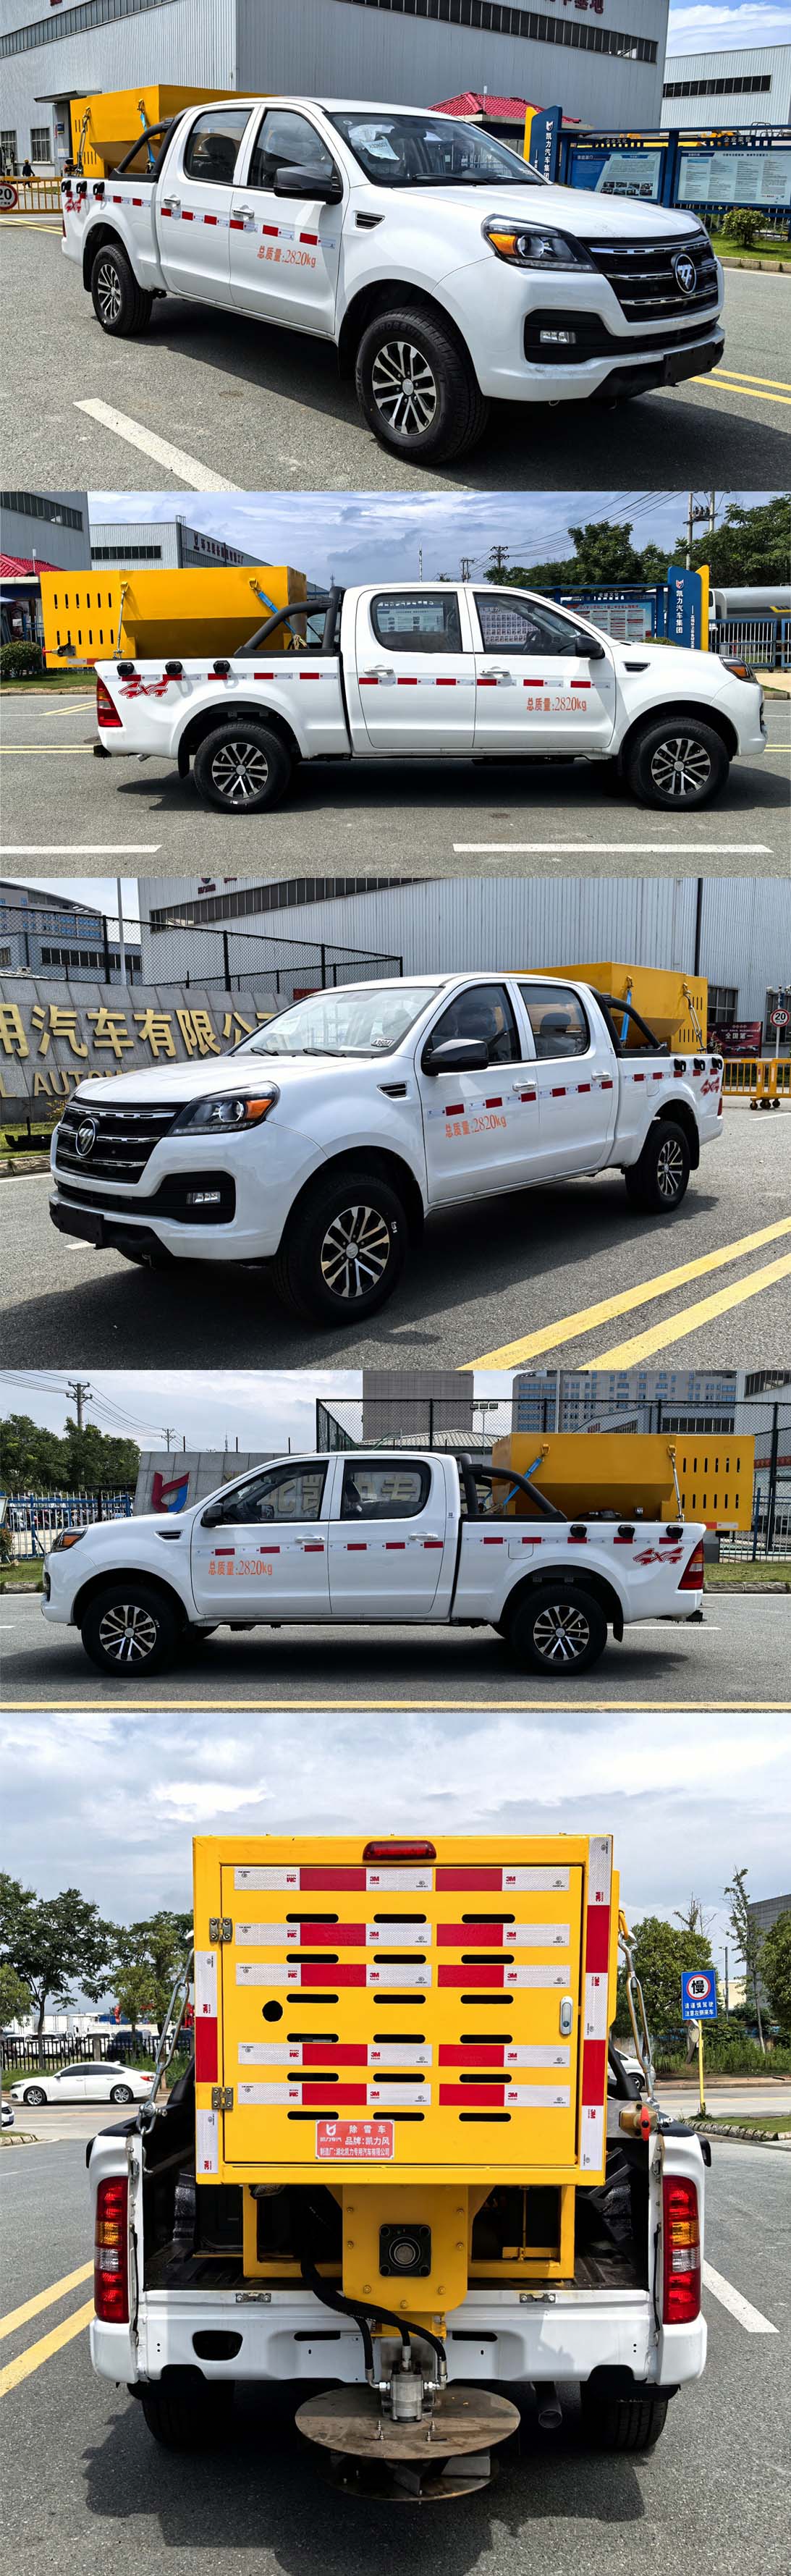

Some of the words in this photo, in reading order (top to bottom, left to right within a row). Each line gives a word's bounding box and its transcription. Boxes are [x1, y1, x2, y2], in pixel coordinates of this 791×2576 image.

[526, 696, 587, 712] 总质量:2820kg
[0, 1003, 279, 1058] 用汽车有限公
[208, 1560, 272, 1576] 总质量:2820kg
[596, 1891, 601, 1902] 3M
[595, 1977, 599, 1986] 3M
[691, 1980, 705, 1994] 慢
[203, 2004, 208, 2014] 3M
[591, 2109, 596, 2119] 3M
[349, 2125, 386, 2134] 除雪车
[344, 2136, 390, 2145] 品牌:凯力风
[204, 2161, 209, 2170] 3M
